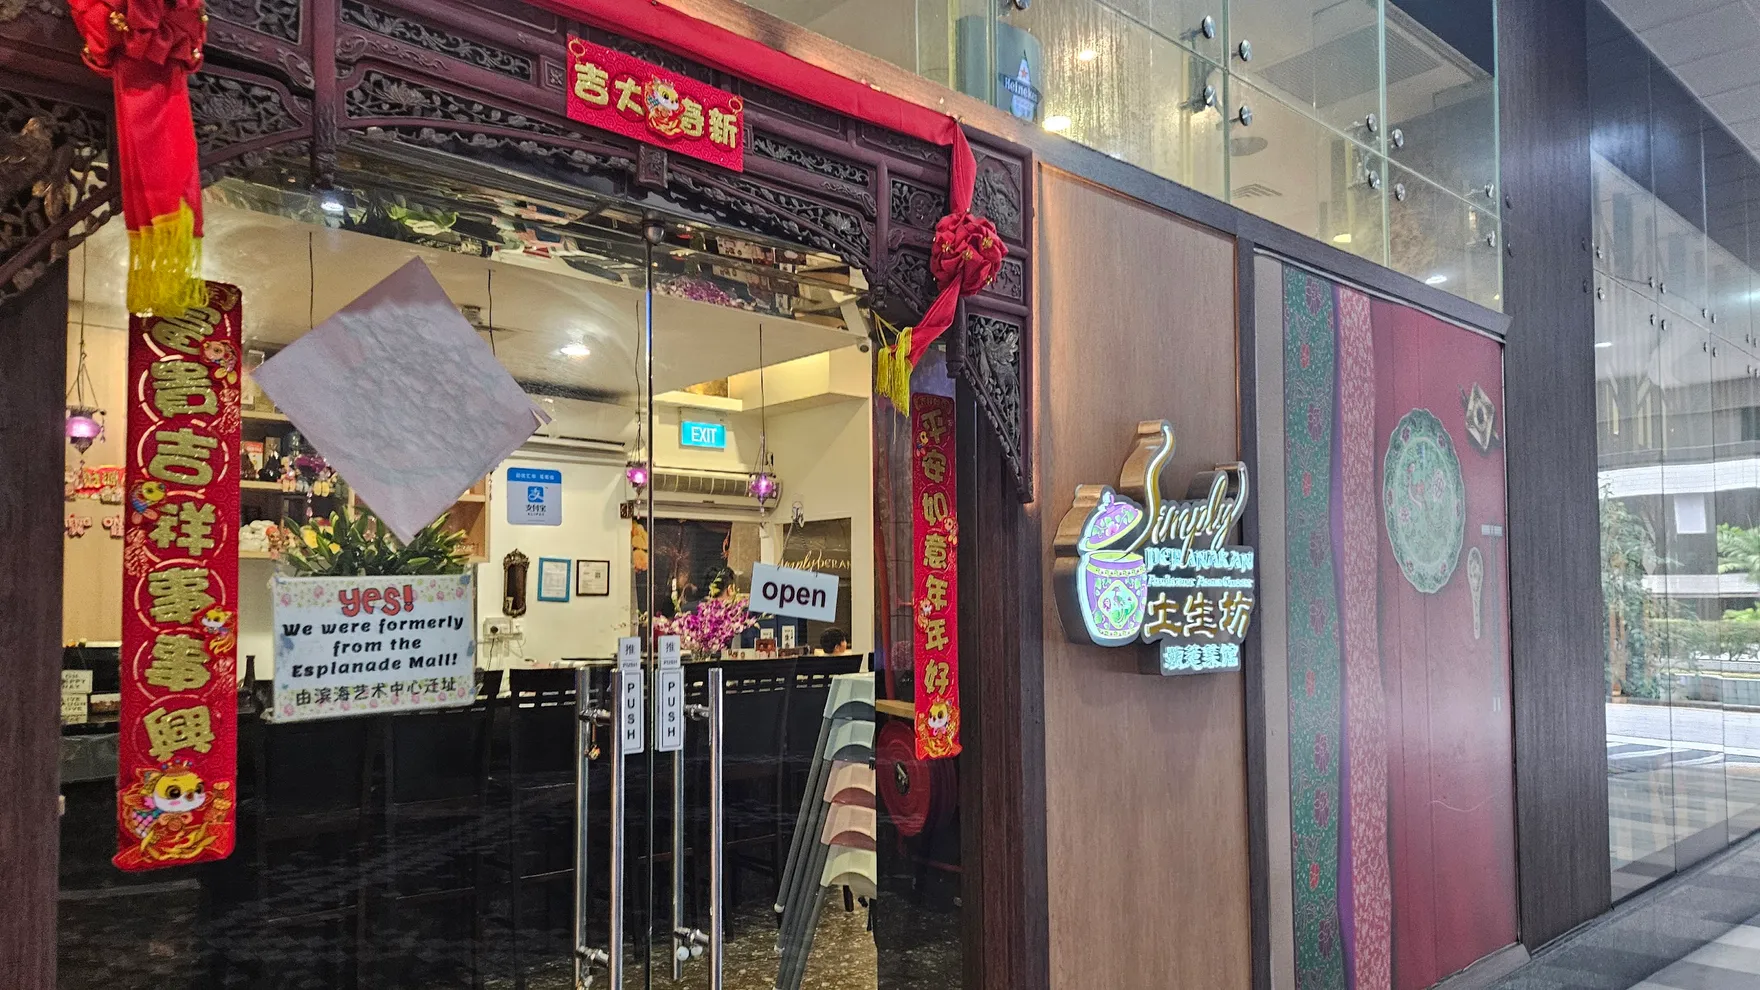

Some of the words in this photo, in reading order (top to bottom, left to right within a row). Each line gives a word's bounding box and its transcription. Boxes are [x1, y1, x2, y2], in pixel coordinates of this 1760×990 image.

[691, 426, 717, 444] EXIT
[1121, 425, 1246, 567] Simply
[921, 408, 949, 694] 平安如意年年好
[762, 581, 826, 609] open
[282, 623, 313, 637] We
[321, 620, 371, 635] were
[378, 615, 464, 634] formerly
[1144, 590, 1253, 638] 土生坊
[333, 639, 382, 657] from
[390, 637, 422, 651] the
[625, 643, 635, 655] 推
[666, 642, 675, 653] 推
[291, 656, 401, 679] Esplanade
[409, 652, 458, 669] Mall!
[296, 676, 457, 707] 由滨海艺术中心迁址
[627, 682, 636, 740] PUSH
[667, 681, 676, 738] PUSH
